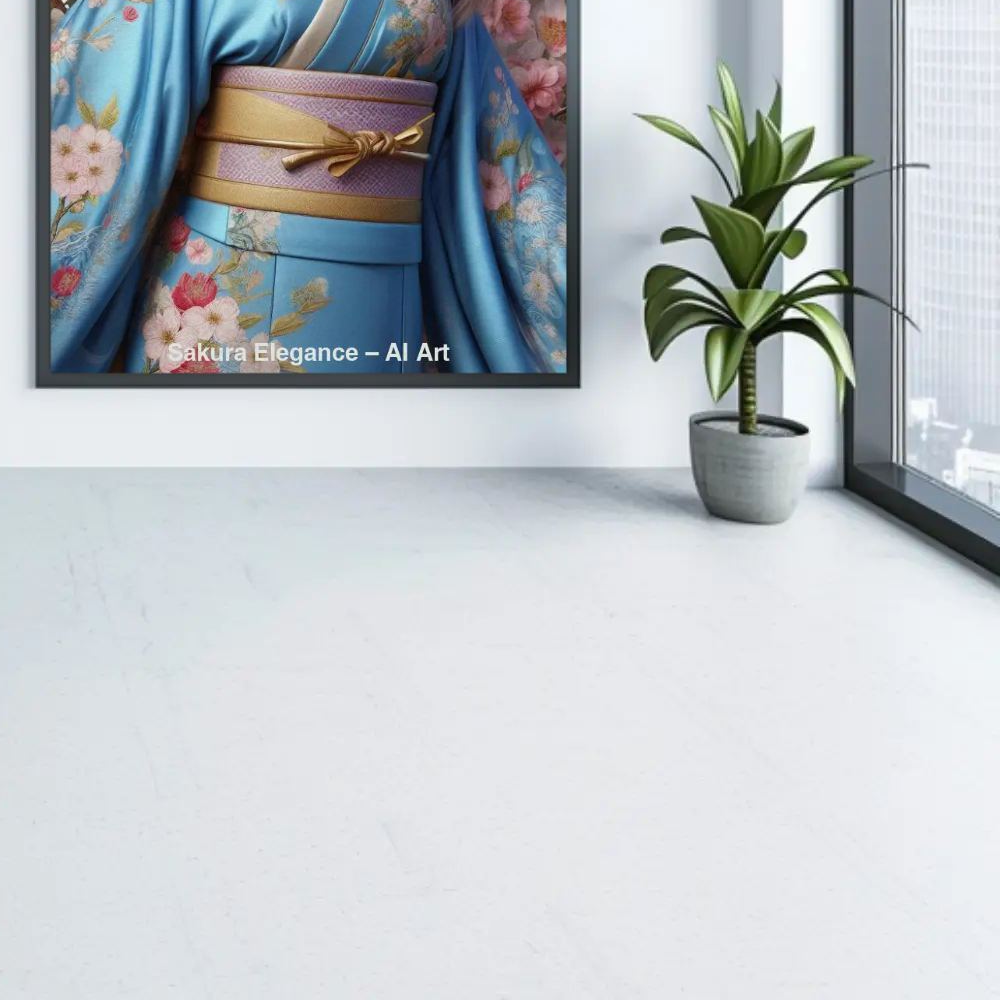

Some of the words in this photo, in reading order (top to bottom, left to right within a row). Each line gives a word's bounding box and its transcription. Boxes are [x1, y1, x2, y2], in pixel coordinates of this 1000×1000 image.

[167, 342, 247, 362] Sakura
[254, 342, 359, 366] Elegance
[385, 342, 408, 362] AI
[416, 342, 450, 362] Art
